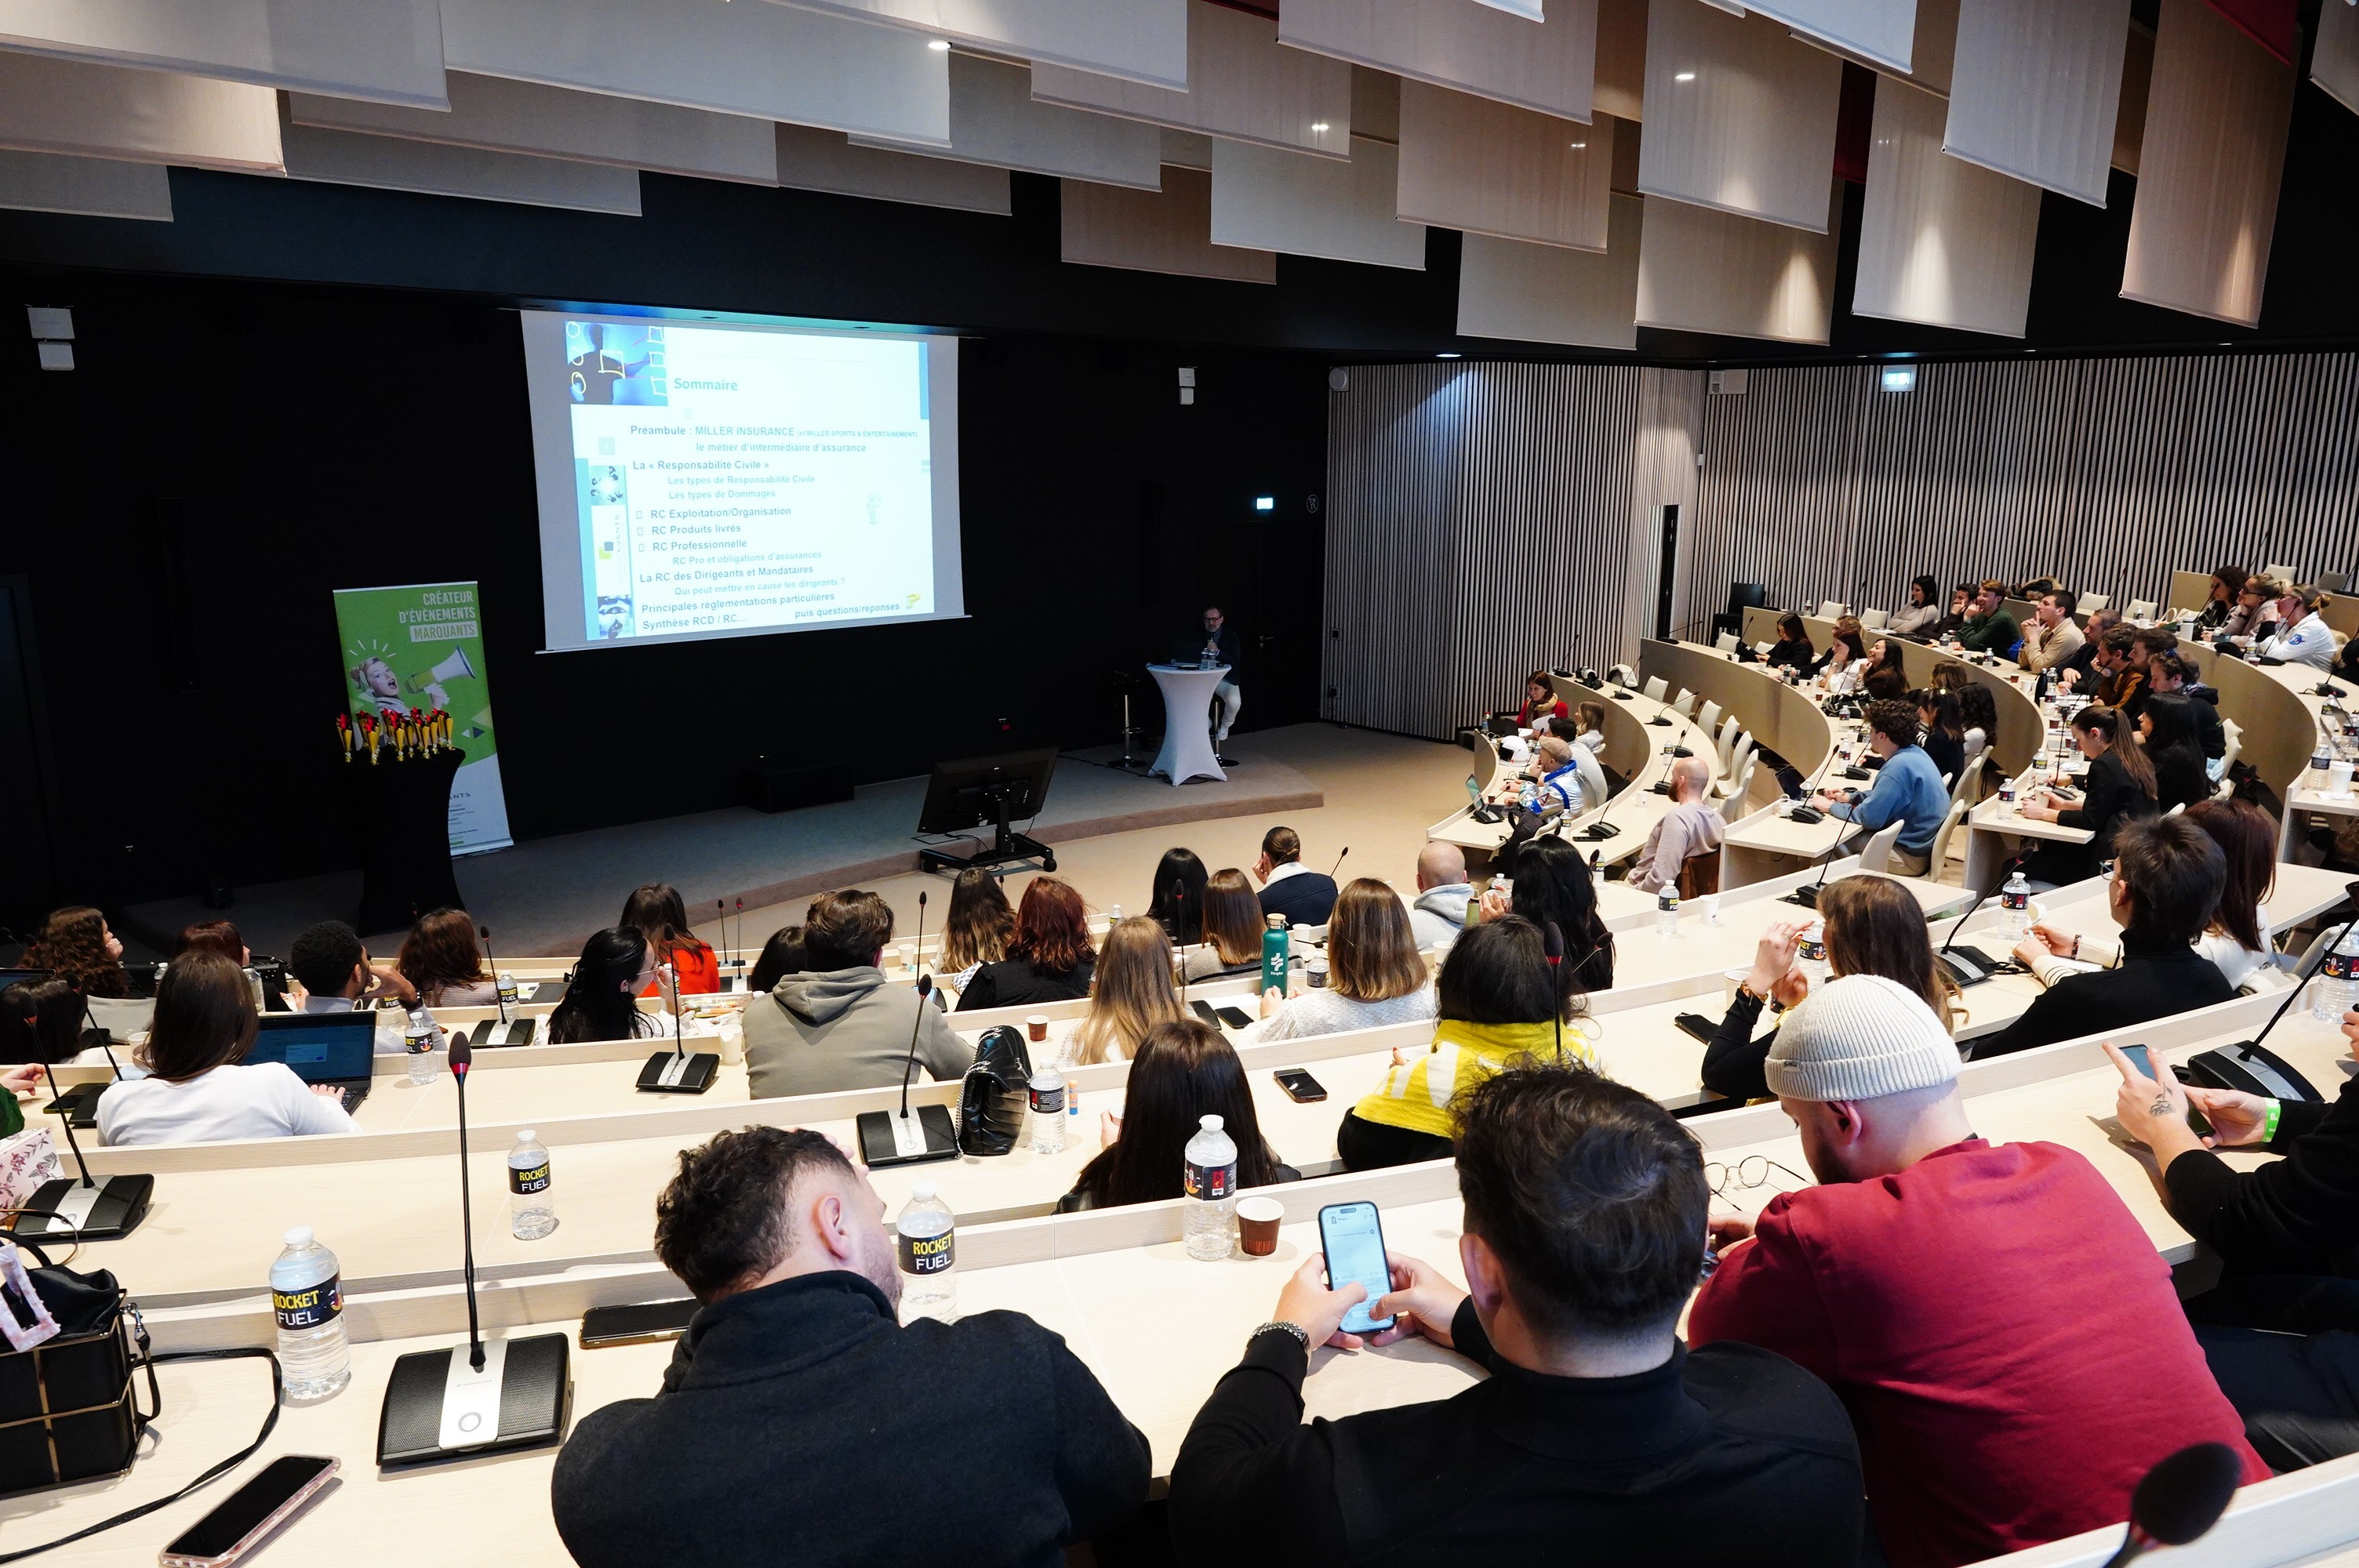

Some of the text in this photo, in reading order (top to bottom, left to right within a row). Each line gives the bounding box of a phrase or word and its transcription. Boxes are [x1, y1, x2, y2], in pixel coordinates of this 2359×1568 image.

[674, 377, 738, 390] Sommaire
[631, 426, 685, 435] Préambule
[695, 426, 733, 435] MILLER
[736, 426, 794, 436] INSURANCE
[741, 443, 810, 452] d'intermédiaire
[813, 443, 867, 452] d'assurance
[633, 461, 645, 470] La
[658, 460, 732, 471] Responsabilité
[735, 460, 761, 470] Civile
[668, 476, 685, 485] Les
[687, 477, 711, 486] types
[727, 475, 791, 485] Responsabilité
[688, 491, 712, 500] types
[728, 489, 776, 499] Dommages
[651, 507, 791, 520] RC Exploitation/Organisation
[652, 524, 741, 535] RC Produits livrés
[652, 539, 747, 551] RC Professionnelle
[673, 557, 686, 565] RC
[689, 556, 705, 564] Pro
[718, 554, 765, 564] obligations
[768, 552, 822, 561] d'assurances
[640, 574, 652, 583] La
[656, 573, 671, 582] RC
[674, 572, 692, 581] des
[695, 568, 744, 581] Dirigeants
[758, 565, 813, 576] Mandataires
[674, 587, 690, 596] Qui
[692, 586, 713, 596] peut
[714, 584, 743, 593] mettre
[798, 578, 838, 589] dirigeants
[423, 590, 474, 605] CRÉATEUR
[642, 593, 835, 613] Principales réglementations particulières
[795, 609, 814, 619] puis
[816, 603, 900, 618] questions/réponses
[642, 619, 689, 631] Synthèse
[692, 616, 715, 626] RCD
[414, 624, 474, 640] MARQUANTS
[500, 988, 517, 996] ROCKET
[519, 1165, 549, 1182] ROCKET
[522, 1178, 548, 1192] FUEL
[913, 1232, 953, 1255] ROCKET
[915, 1254, 951, 1271] FUEL
[273, 1290, 321, 1309] ROCKET
[278, 1310, 320, 1326] FUEL
